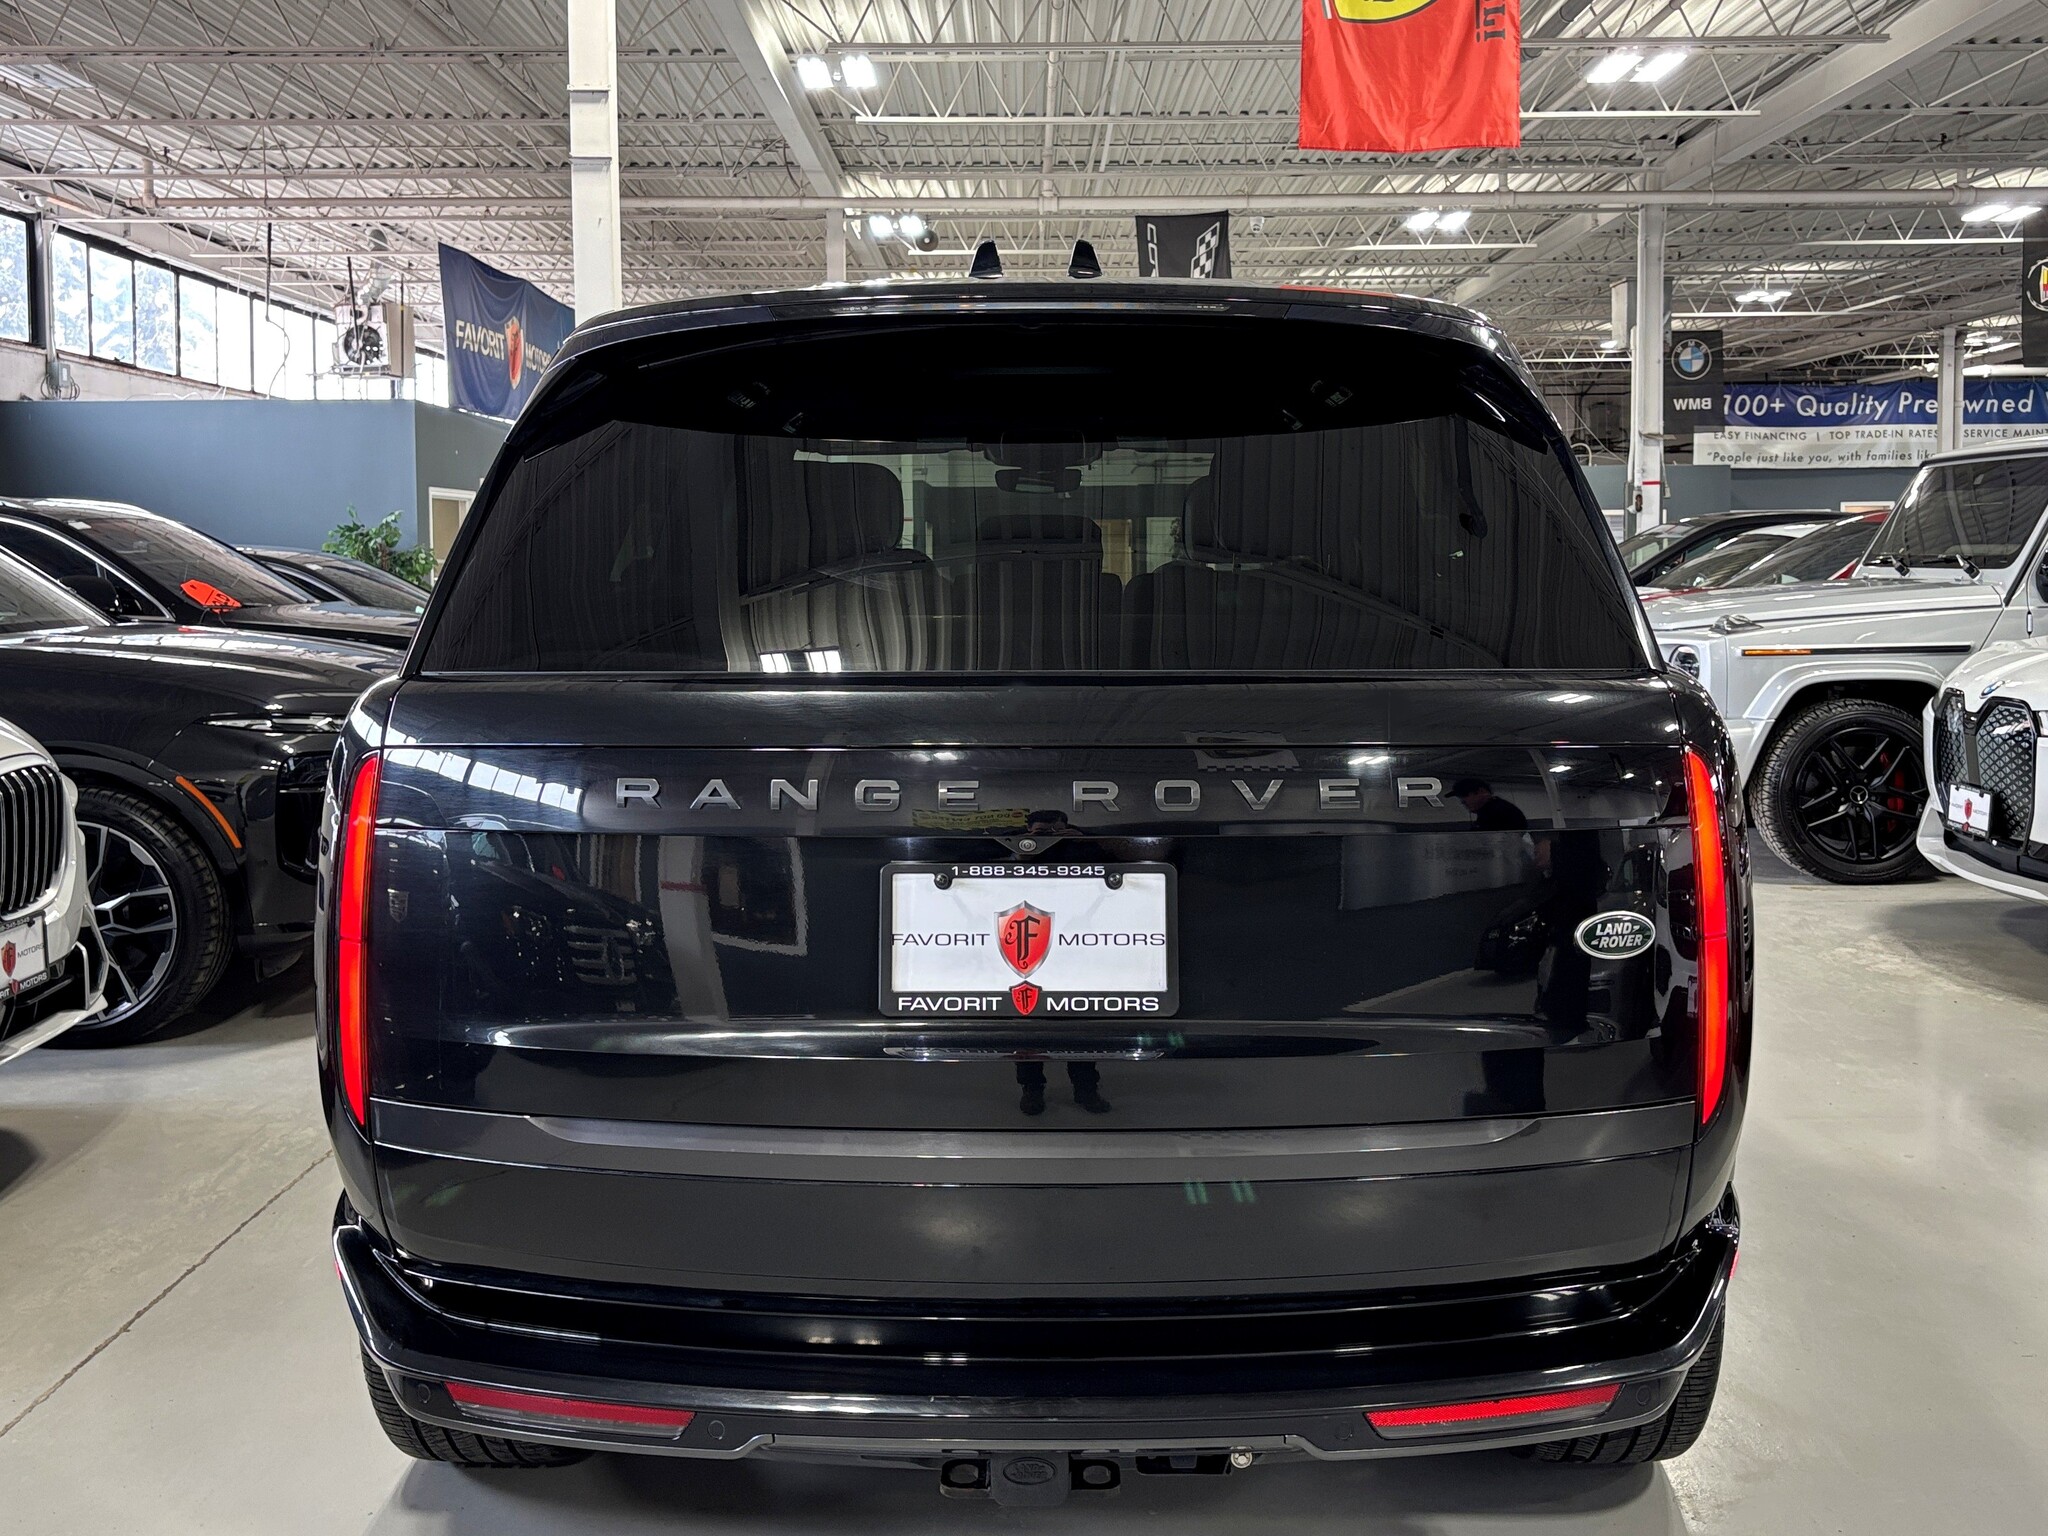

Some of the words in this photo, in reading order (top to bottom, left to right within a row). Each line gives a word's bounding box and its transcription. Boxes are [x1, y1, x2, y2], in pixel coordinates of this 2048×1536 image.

[455, 320, 505, 361] FAVORIT
[1723, 394, 1785, 416] 100+
[1796, 392, 1889, 421] Quality
[1714, 431, 1740, 440] EASY
[1745, 431, 1807, 441] FINANCING
[1829, 431, 1851, 440] TOP
[1855, 429, 1903, 440] TRADE-IN
[1963, 428, 2008, 439] SERVICE
[1757, 451, 1779, 464] just
[1783, 451, 1804, 463] like
[1807, 454, 1832, 465] you,
[1838, 451, 1862, 462] with
[1866, 450, 1912, 462] families
[616, 778, 980, 812] RANGE
[1072, 776, 1445, 812] ROVER
[951, 865, 1106, 877] 1-888-345-9345
[1595, 922, 1633, 936] LAND
[891, 932, 991, 946] FAVORIT
[1058, 932, 1166, 946] MOTORS
[1598, 934, 1643, 948] ROVER
[20, 972, 48, 990] MOTORS
[898, 996, 1003, 1012] FAVORIT
[1046, 996, 1160, 1011] MOTORS
